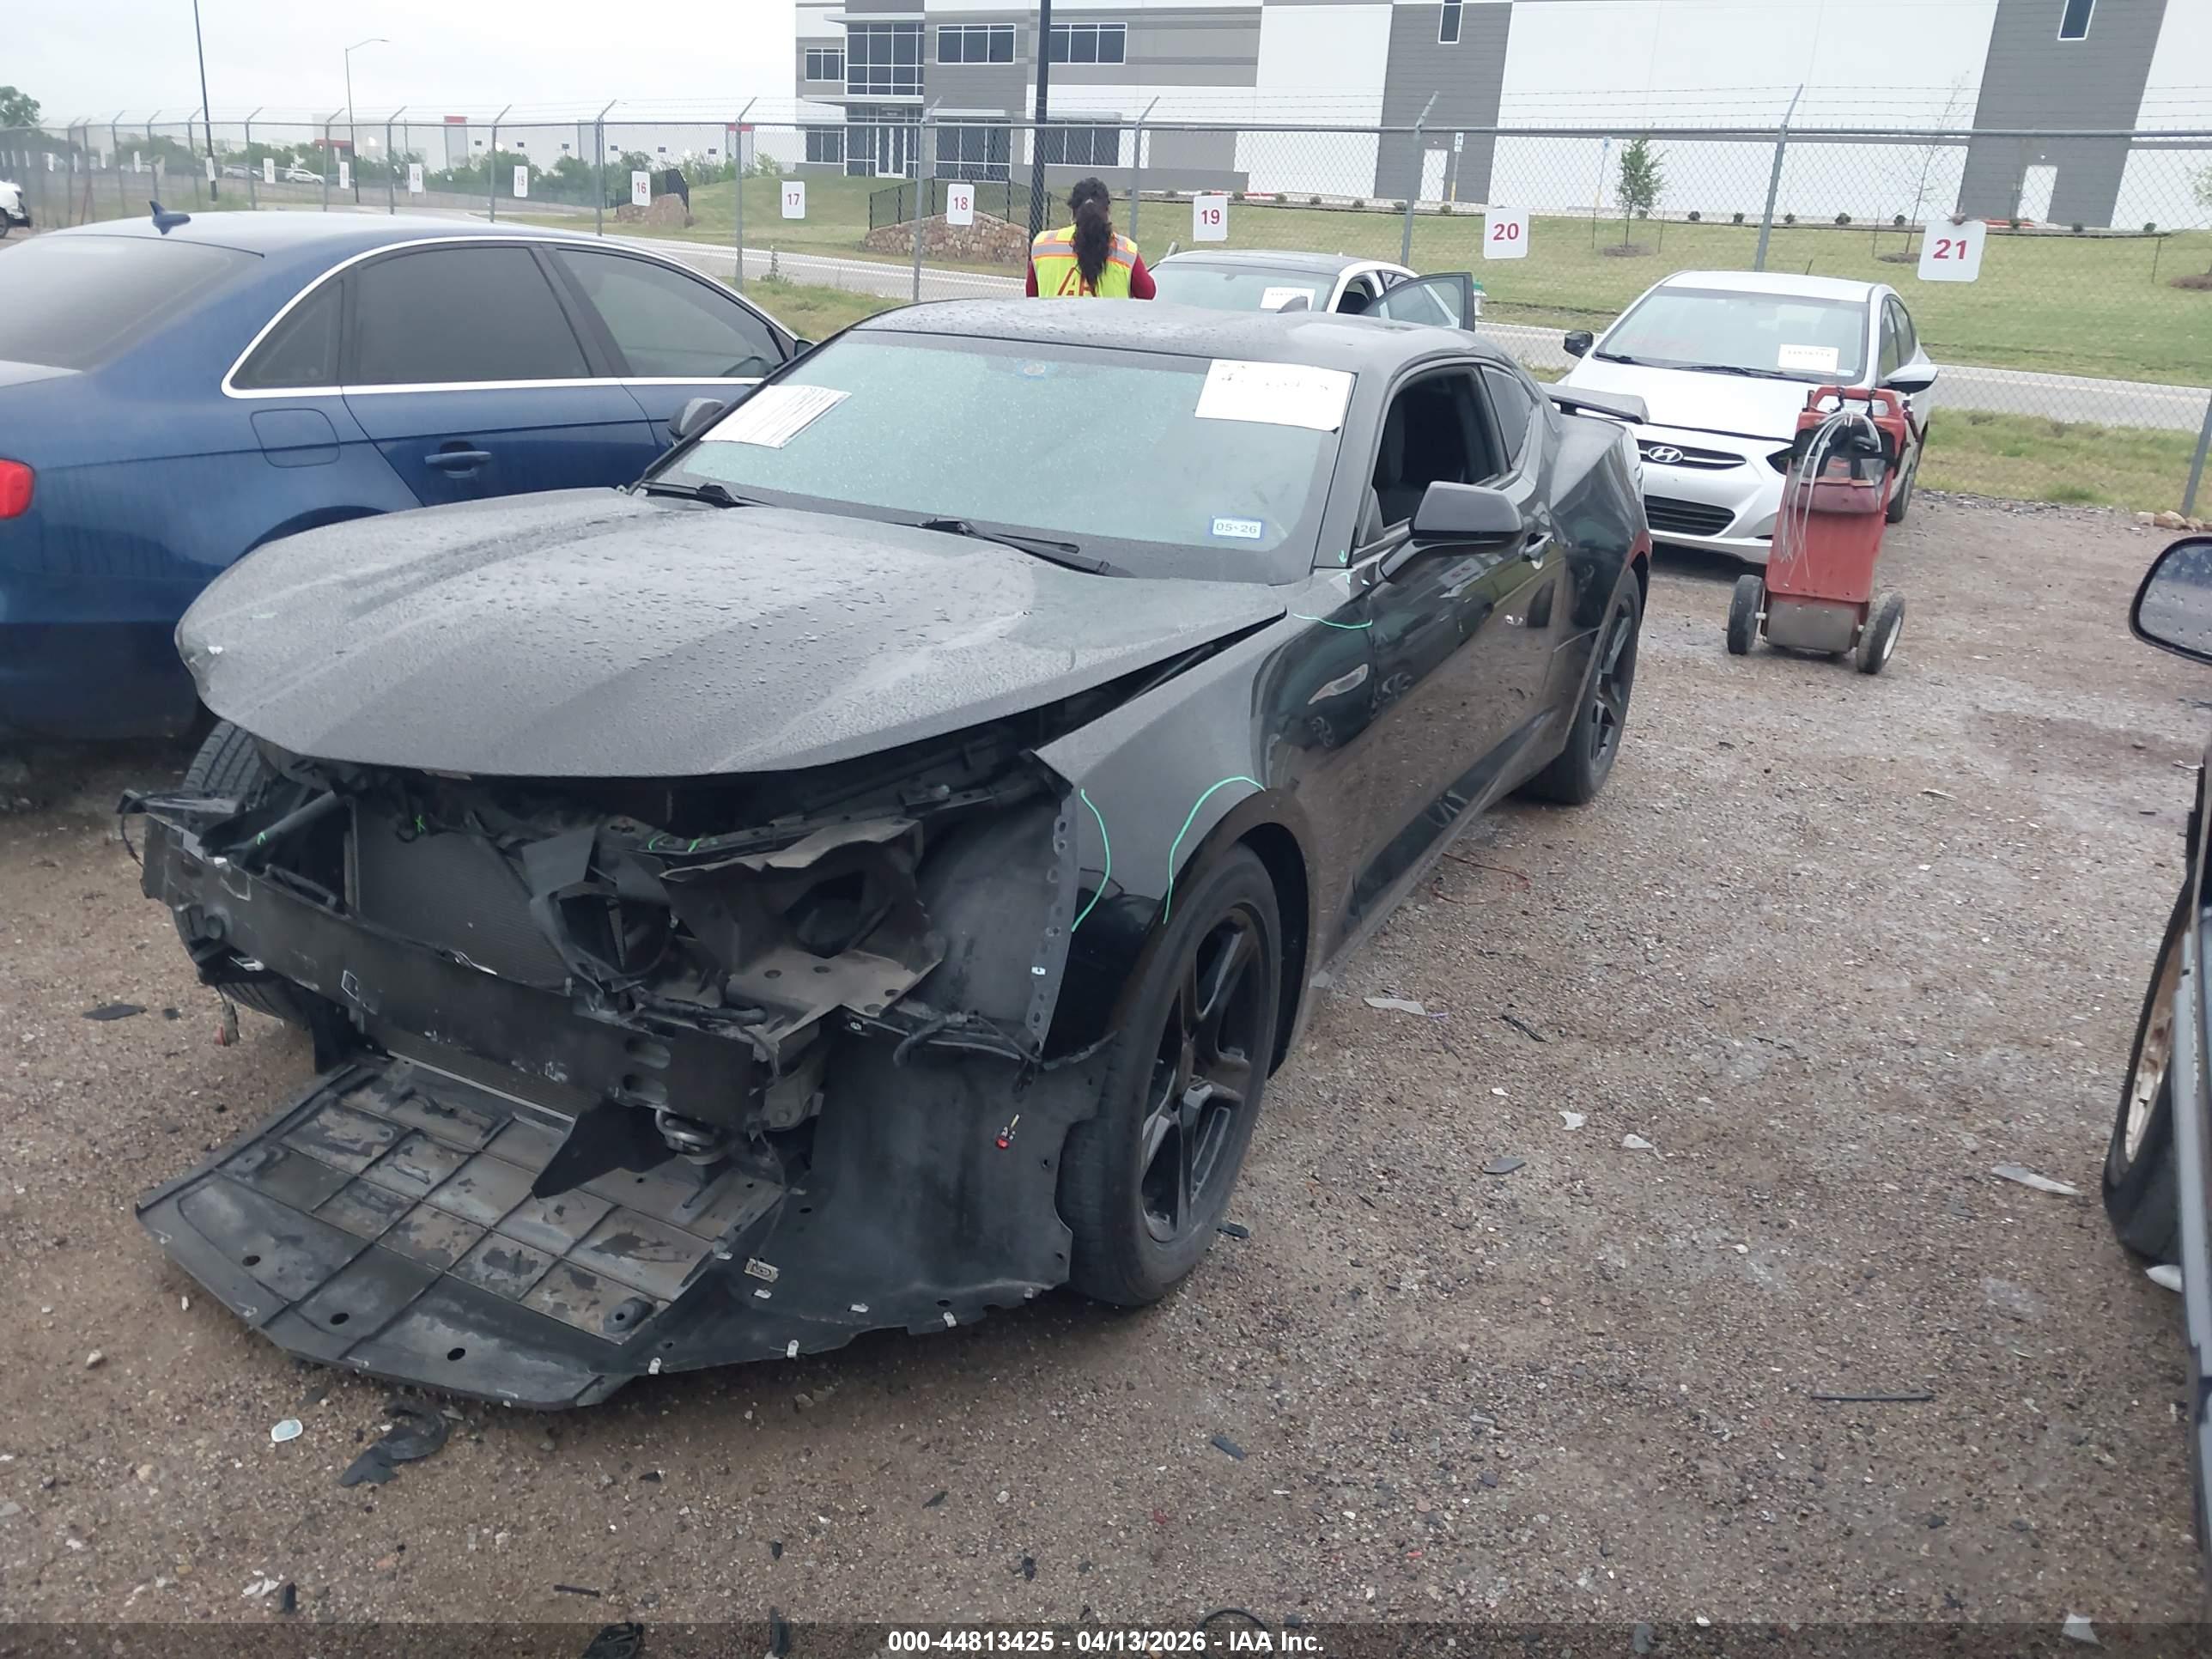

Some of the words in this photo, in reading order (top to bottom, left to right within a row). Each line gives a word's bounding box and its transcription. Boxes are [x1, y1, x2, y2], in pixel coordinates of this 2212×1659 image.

[636, 181, 647, 194] 16
[787, 193, 800, 205] 17
[953, 197, 969, 210] 18
[1200, 209, 1220, 225] 19
[1492, 222, 1520, 241] 20
[1933, 239, 1967, 260] 21
[1216, 522, 1258, 534] 05-26
